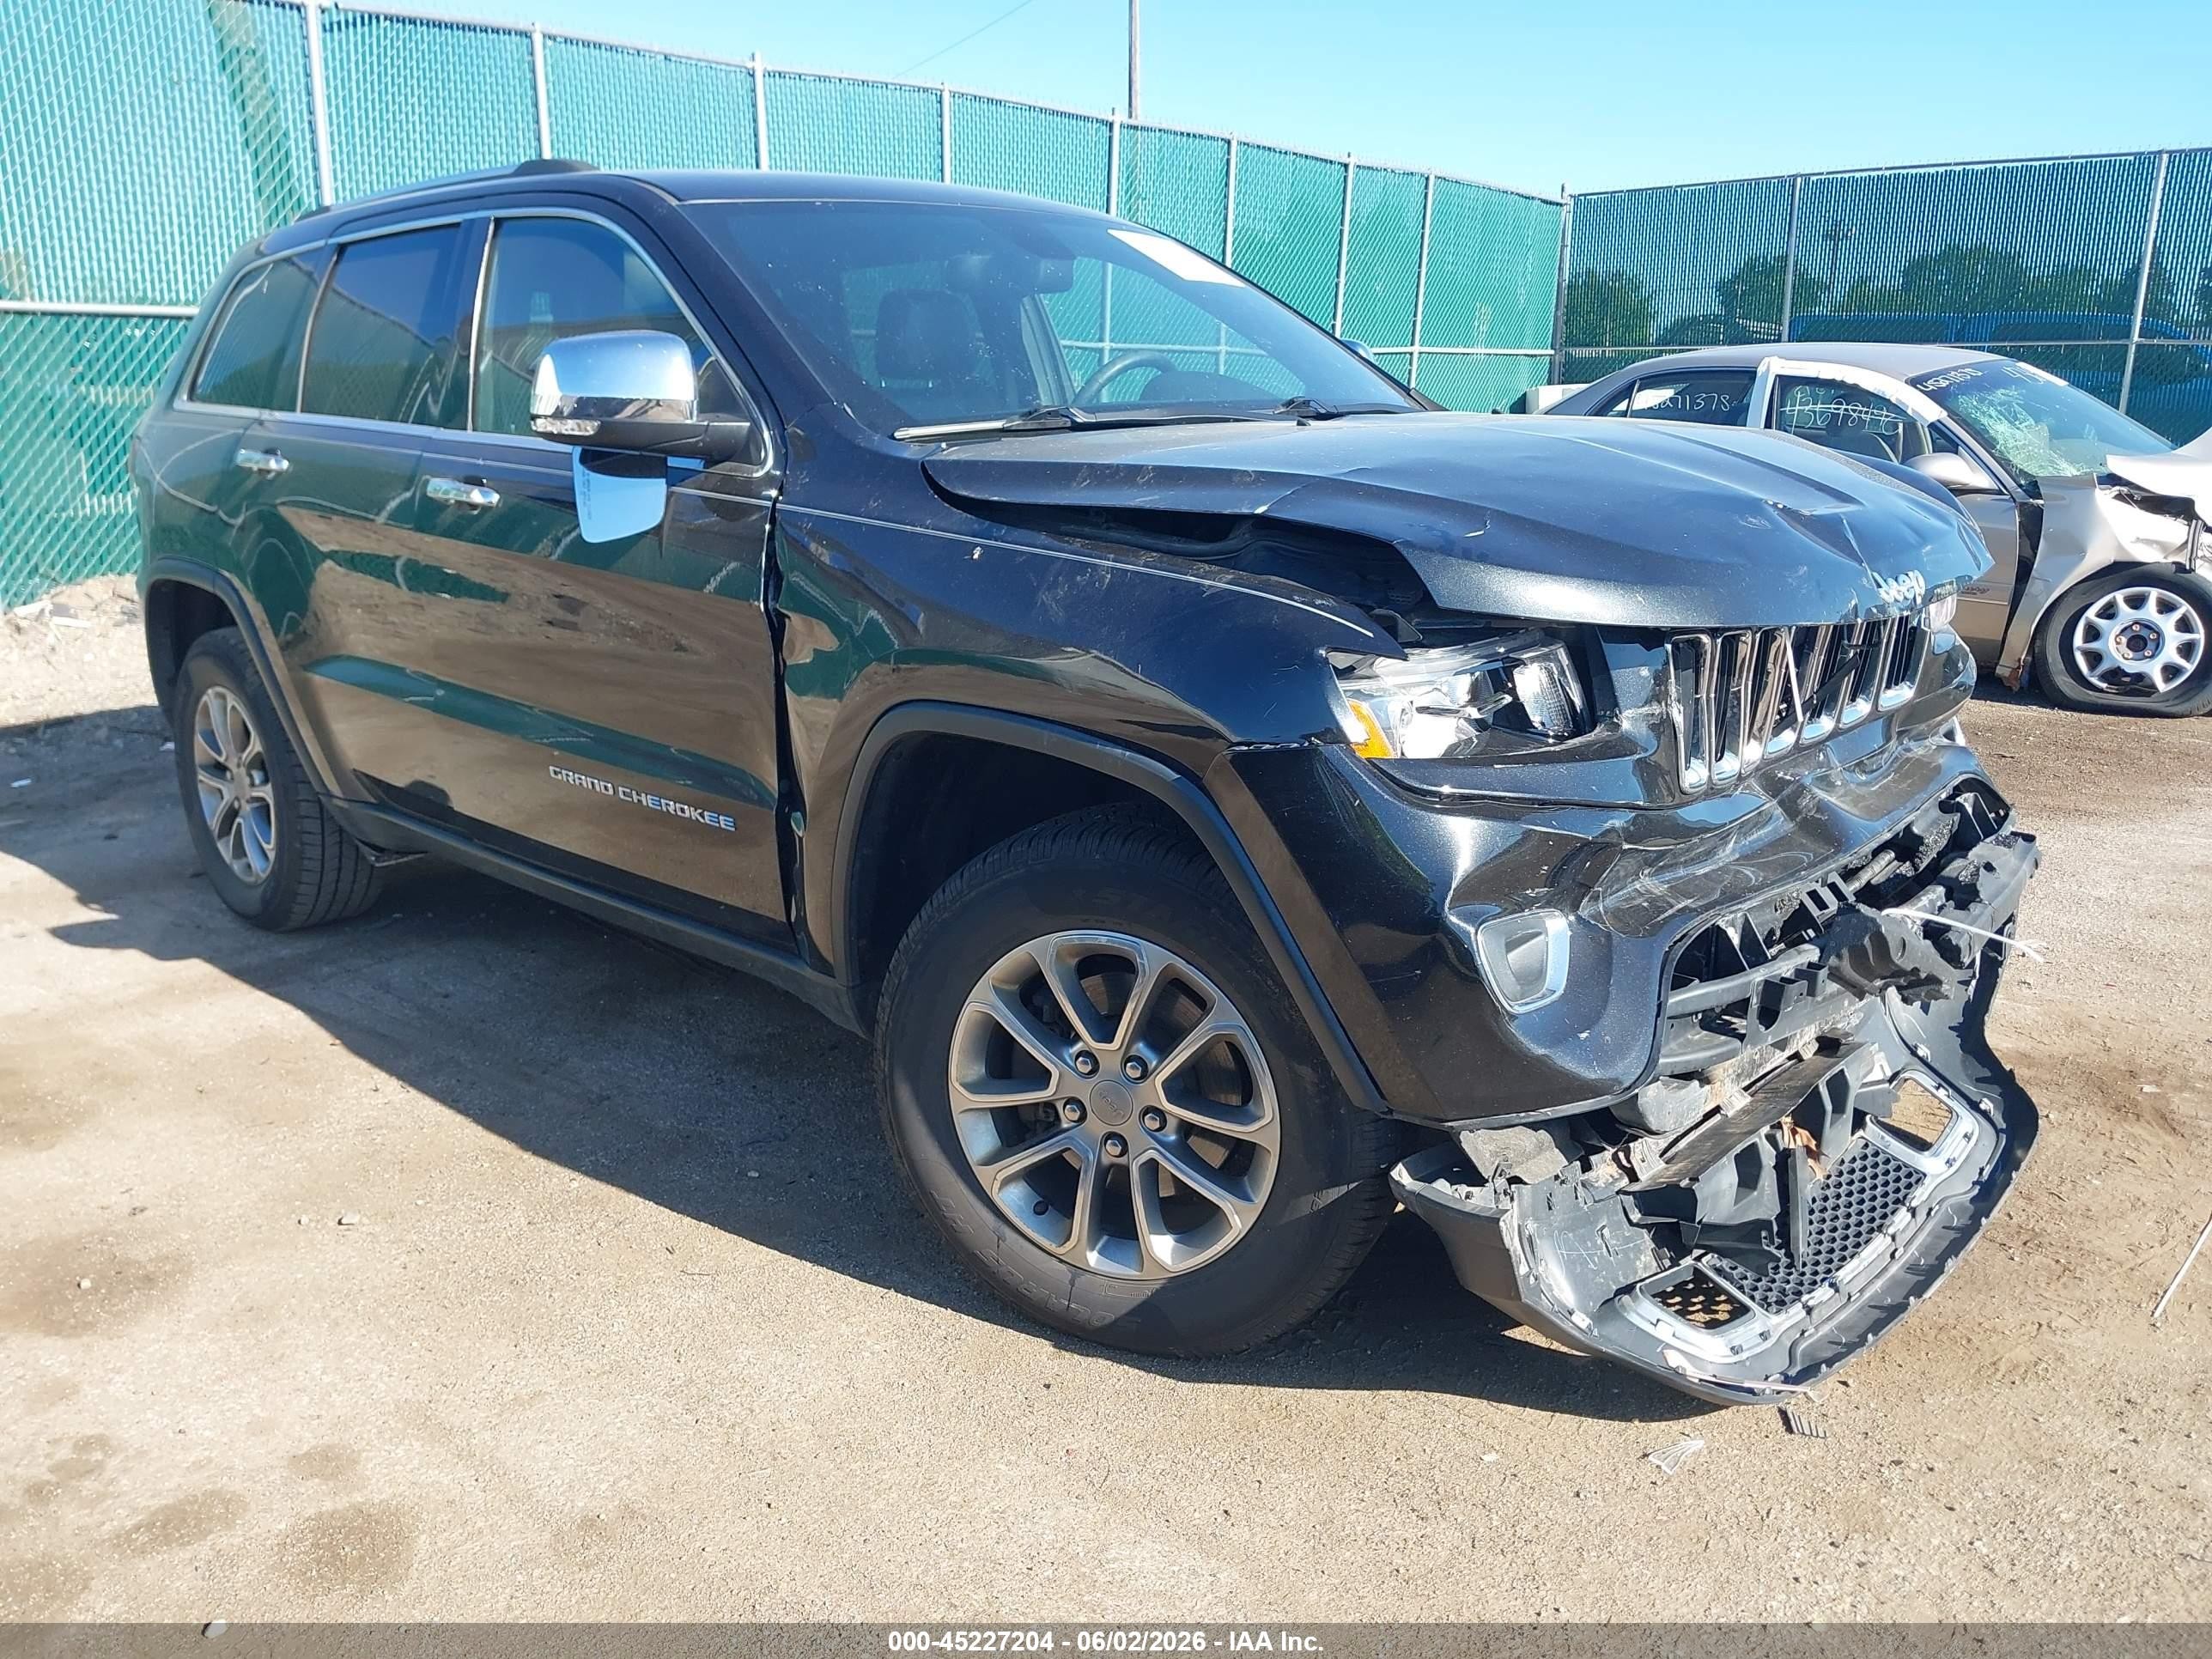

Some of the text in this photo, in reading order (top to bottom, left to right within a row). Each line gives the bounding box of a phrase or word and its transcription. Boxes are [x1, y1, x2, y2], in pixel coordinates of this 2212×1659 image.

[1870, 569, 1926, 605] Jeep
[549, 765, 737, 832] GRAND CHEROKEE
[973, 1247, 1140, 1329] OLARUS
